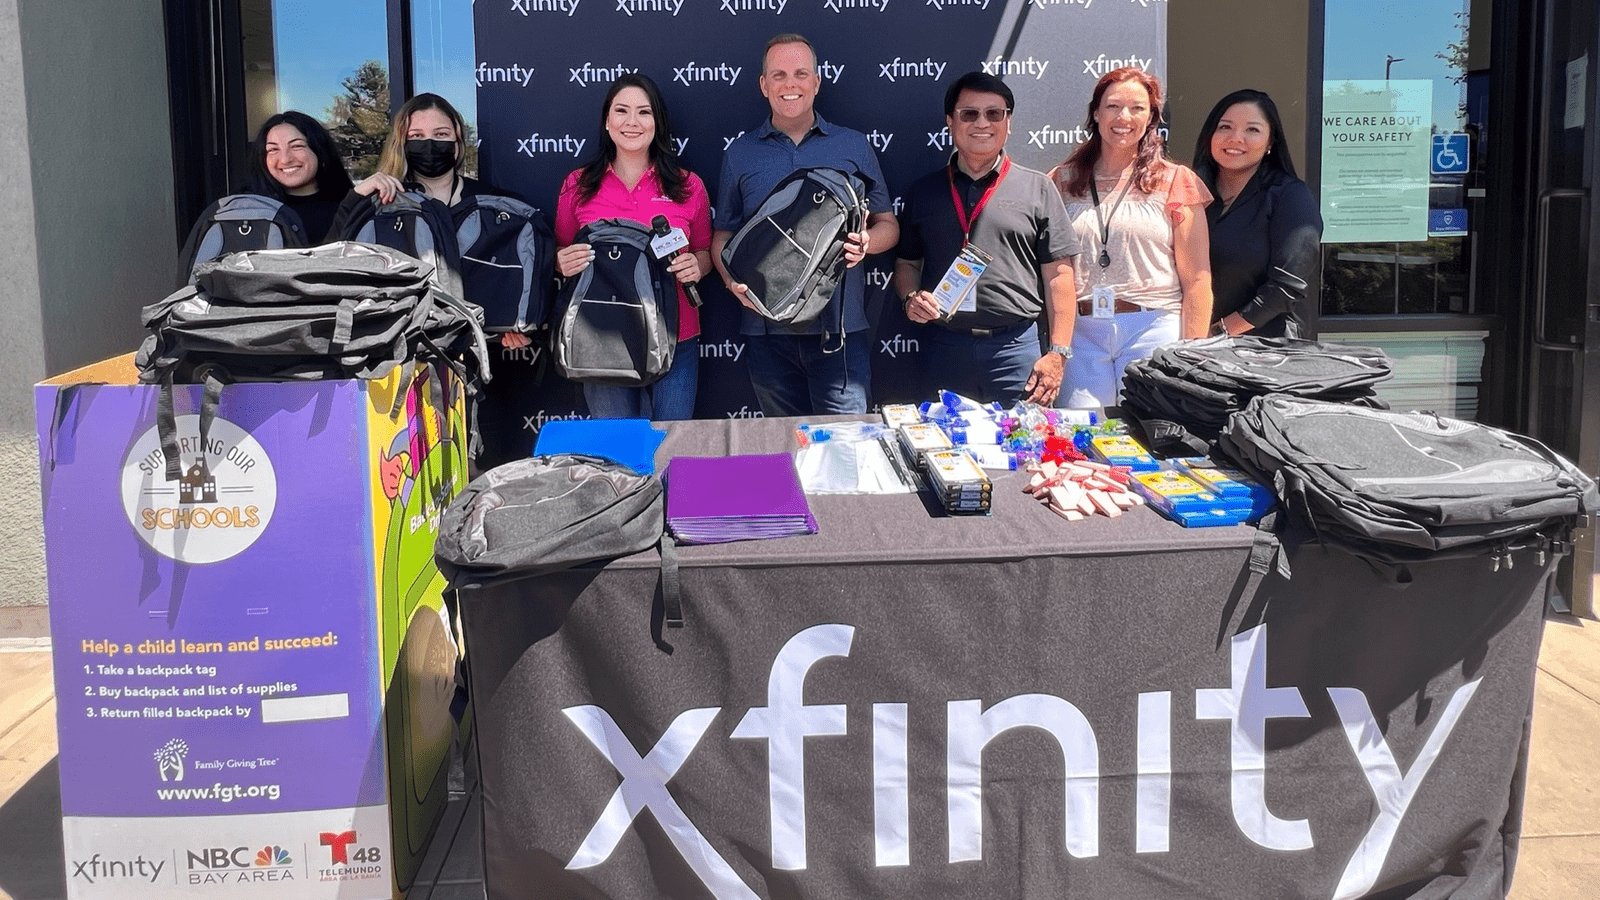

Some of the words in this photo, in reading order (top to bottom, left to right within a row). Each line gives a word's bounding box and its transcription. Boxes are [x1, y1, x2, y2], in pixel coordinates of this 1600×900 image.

[673, 61, 742, 87] xfinity
[879, 57, 947, 82] xfinity
[981, 55, 1049, 80] xfinity
[1323, 117, 1341, 126] WE
[1345, 117, 1377, 126] CARE
[1381, 116, 1421, 126] ABOUT
[517, 133, 586, 158] xfinity
[1332, 133, 1365, 142] YOUR
[1369, 132, 1412, 142] SAFETY
[226, 446, 255, 474] OUR
[142, 505, 260, 530] SCHOOLS
[82, 639, 119, 657] Help
[123, 643, 133, 654] a
[138, 639, 176, 654] child
[181, 638, 223, 653] learn
[228, 636, 259, 652] and
[264, 631, 338, 651] succeed:
[84, 665, 94, 674] 1.
[97, 664, 124, 675] Take
[127, 667, 135, 675] a
[137, 664, 193, 677] backpack
[196, 665, 217, 677] tag
[85, 686, 96, 696] 2.
[99, 686, 121, 699] Buy
[124, 686, 180, 699] backpack
[183, 685, 205, 696] and
[208, 685, 227, 696] list
[230, 684, 244, 694] of
[246, 682, 298, 696] supplies
[86, 707, 98, 718] 3.
[100, 707, 140, 718] Return
[143, 707, 173, 718] filled
[176, 705, 232, 719] backpack
[235, 705, 251, 718] by
[195, 760, 225, 771] Family
[226, 759, 257, 770] Giving
[562, 622, 1483, 900] xfinity
[157, 782, 281, 803] www.fgt.org
[187, 847, 250, 869] NBC
[352, 847, 381, 863] 48
[72, 853, 166, 884] xfinity
[189, 872, 229, 885] BAY
[237, 869, 294, 883] AREA
[319, 865, 382, 877] TELEMUNDO
